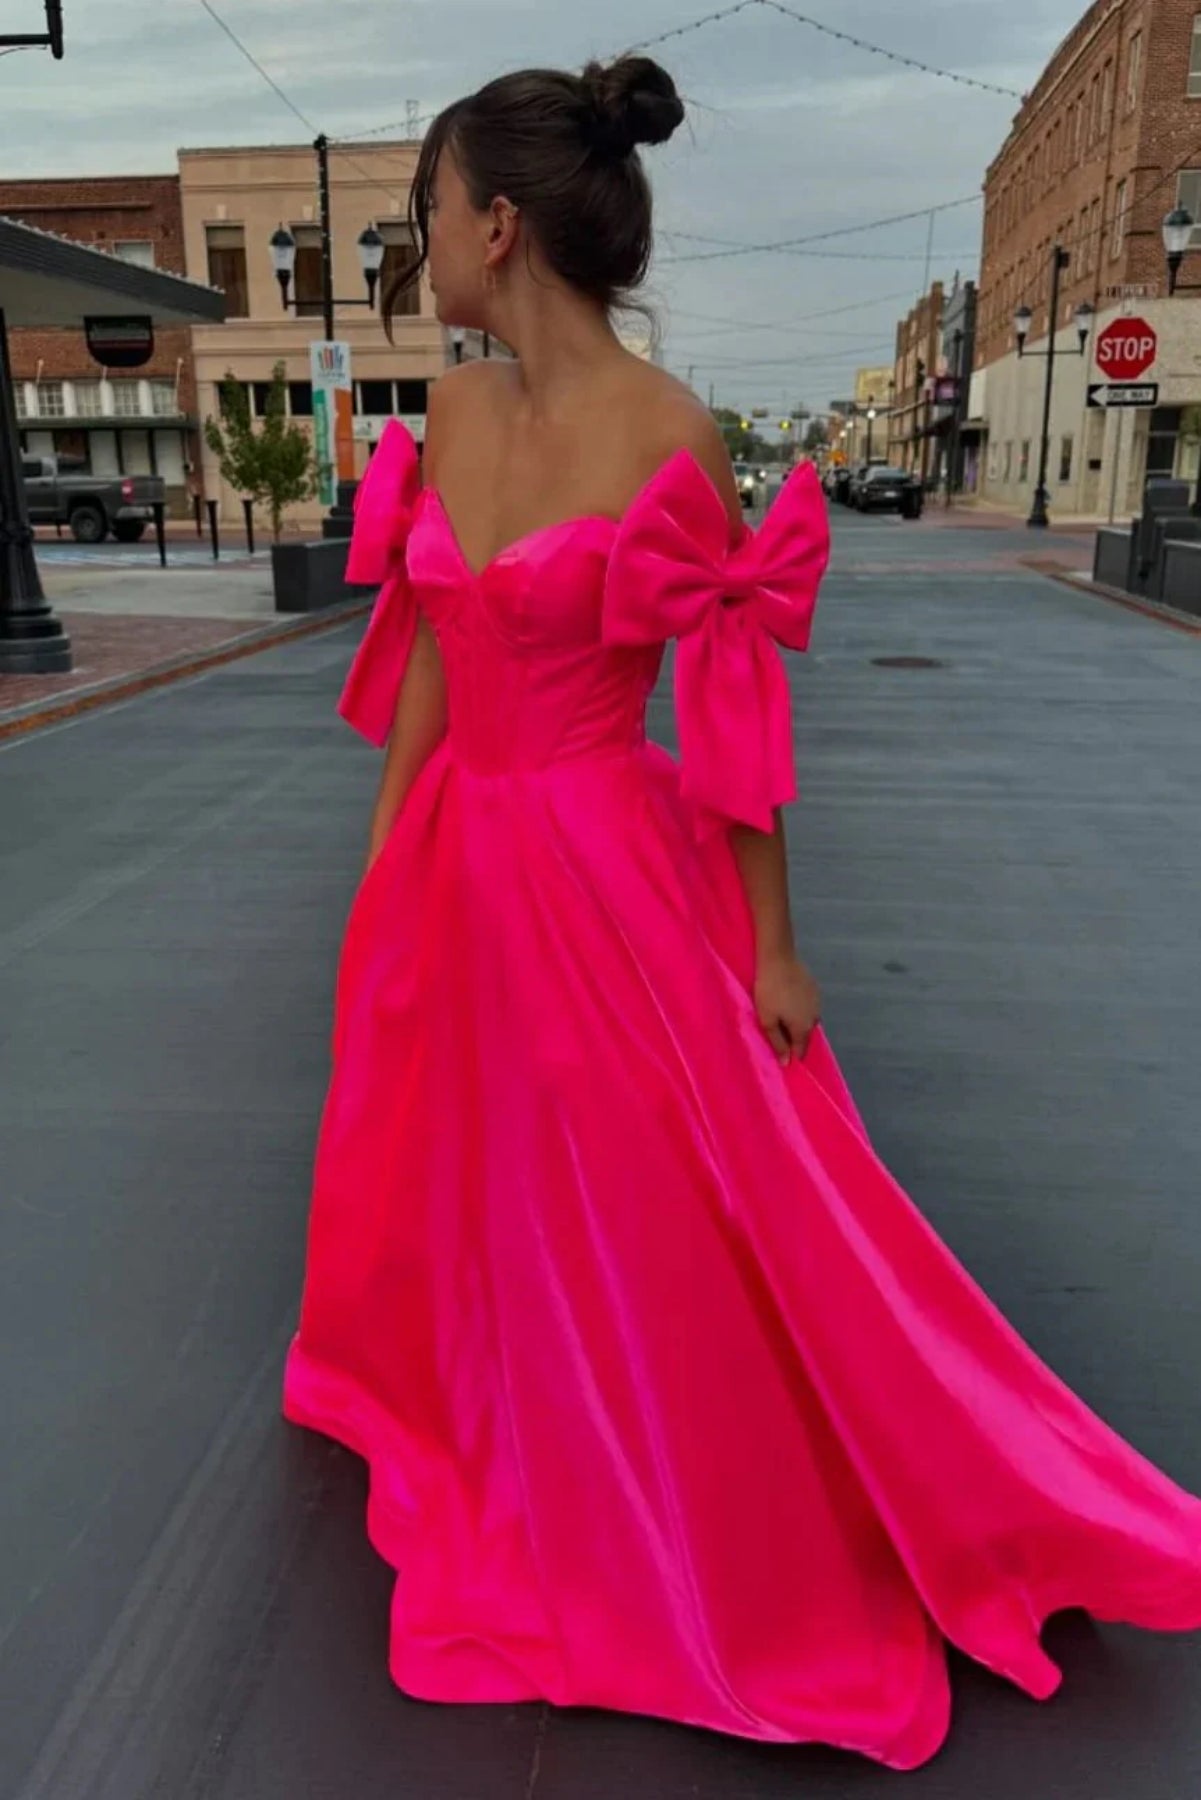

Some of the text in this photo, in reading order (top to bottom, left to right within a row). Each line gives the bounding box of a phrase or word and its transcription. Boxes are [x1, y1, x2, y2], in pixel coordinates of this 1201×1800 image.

[1098, 337, 1154, 362] STOP
[1107, 388, 1150, 400] ONE WAY
